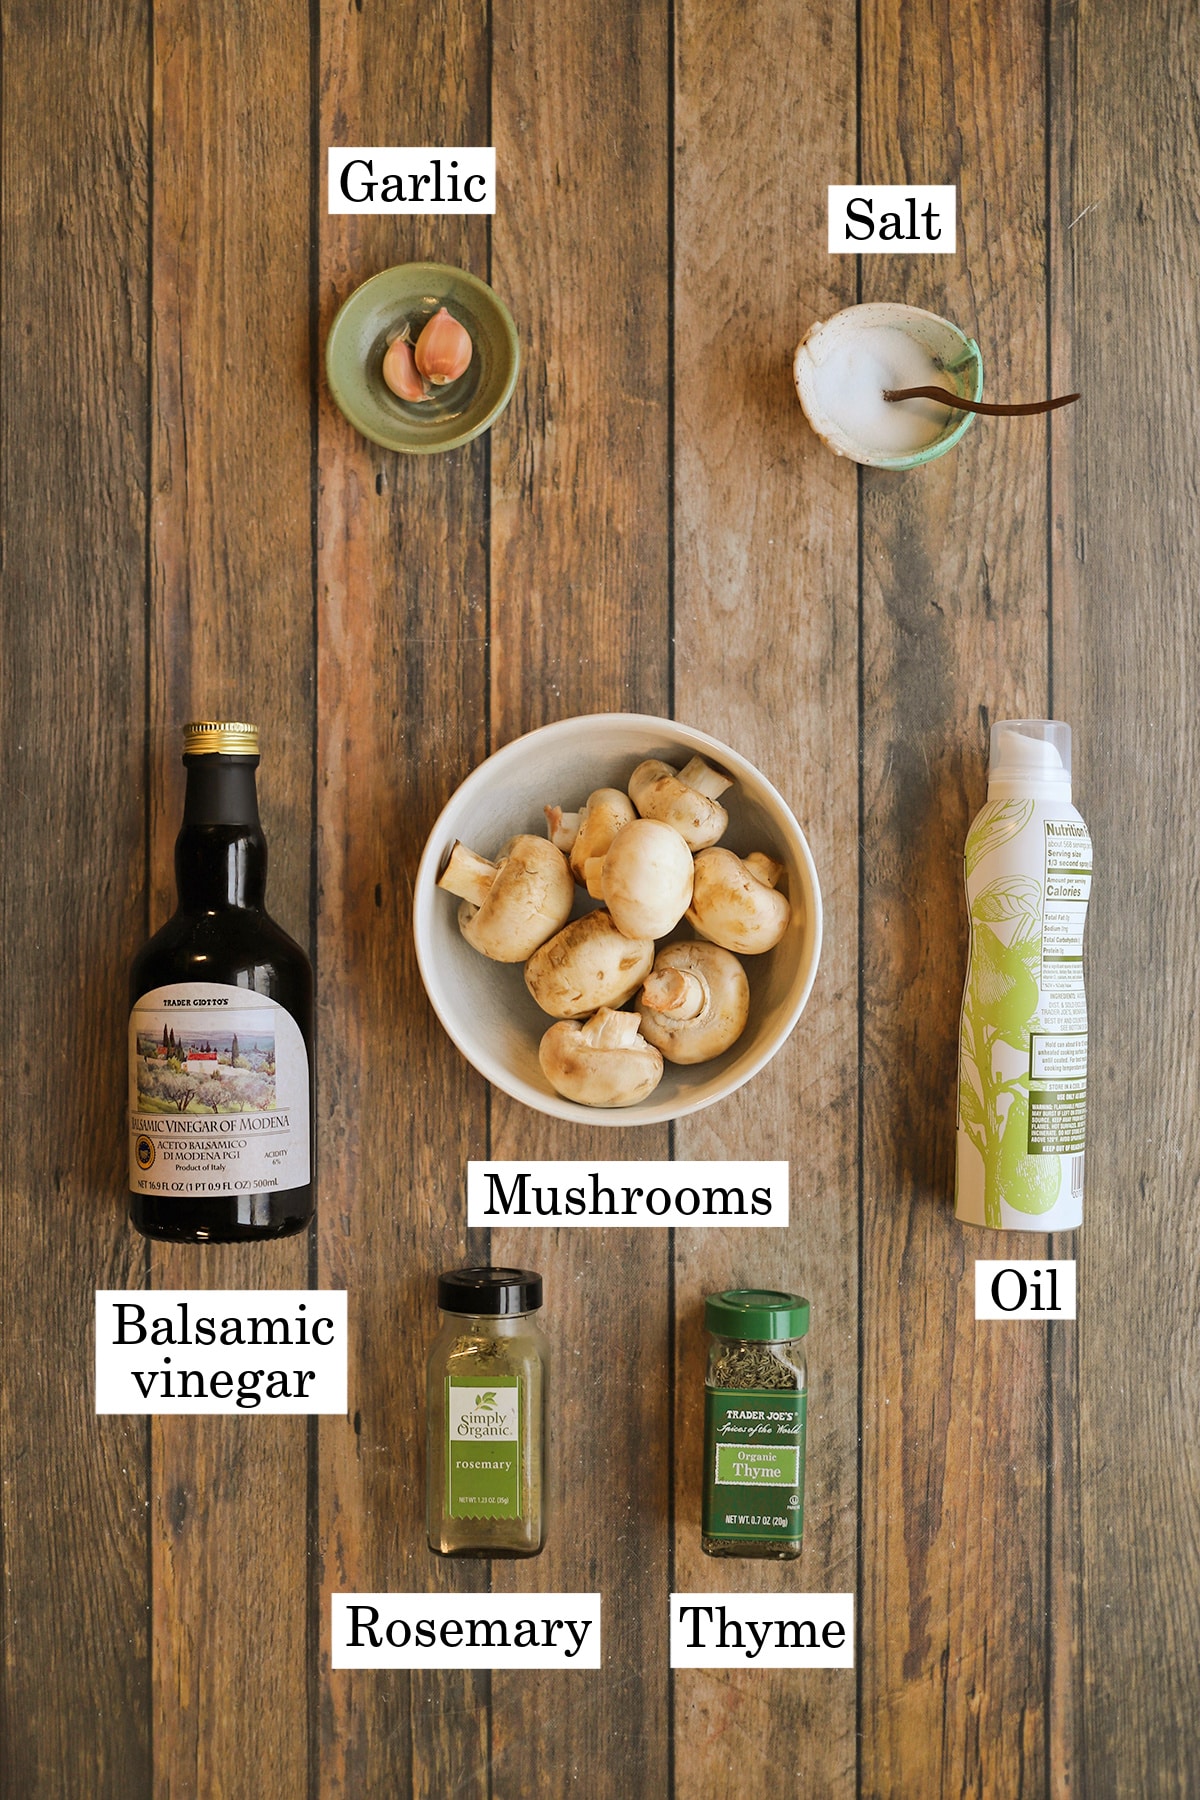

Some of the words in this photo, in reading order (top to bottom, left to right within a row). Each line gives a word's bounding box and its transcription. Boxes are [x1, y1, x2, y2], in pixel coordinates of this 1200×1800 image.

[1047, 823, 1085, 837] Nutrition
[1048, 850, 1071, 858] Serving
[1072, 850, 1082, 858] size
[1047, 884, 1081, 898] Calories
[163, 999, 192, 1007] TRADER
[193, 998, 229, 1006] GIOTTO'S
[132, 1117, 165, 1133] BALSAMIC
[166, 1120, 219, 1133] VINEGAR
[219, 1120, 237, 1133] OF
[239, 1115, 290, 1131] MODENA
[157, 1141, 188, 1150] ACETO
[189, 1140, 248, 1150] BALSAMICO
[163, 1151, 174, 1160] DI
[175, 1151, 221, 1160] MODENA
[222, 1151, 241, 1160] PGI
[264, 1149, 289, 1159] ACIDITY
[175, 1163, 201, 1172] Product
[202, 1163, 210, 1172] of
[210, 1163, 227, 1173] Italy
[138, 1180, 148, 1189] NET
[149, 1181, 161, 1191] 16.9
[162, 1182, 170, 1191] FL
[171, 1182, 185, 1192] OZ
[186, 1182, 193, 1192] (1
[195, 1183, 207, 1191] PT
[208, 1182, 221, 1191] 0.9
[222, 1181, 232, 1190] FL
[234, 1180, 252, 1190] OZ)
[461, 1412, 507, 1428] Simply
[727, 1410, 765, 1420] TRADER
[766, 1411, 794, 1421] JOE'S
[457, 1423, 510, 1439] Organic
[717, 1422, 747, 1436] Spices
[776, 1423, 803, 1435] World
[738, 1451, 777, 1463] Organic
[456, 1460, 512, 1471] rosemary
[732, 1463, 781, 1479] Thyme
[725, 1514, 737, 1524] NET
[738, 1515, 750, 1524] WT.
[751, 1515, 761, 1525] 0.7
[762, 1516, 771, 1525] OZ
[772, 1516, 788, 1528] (20g)
